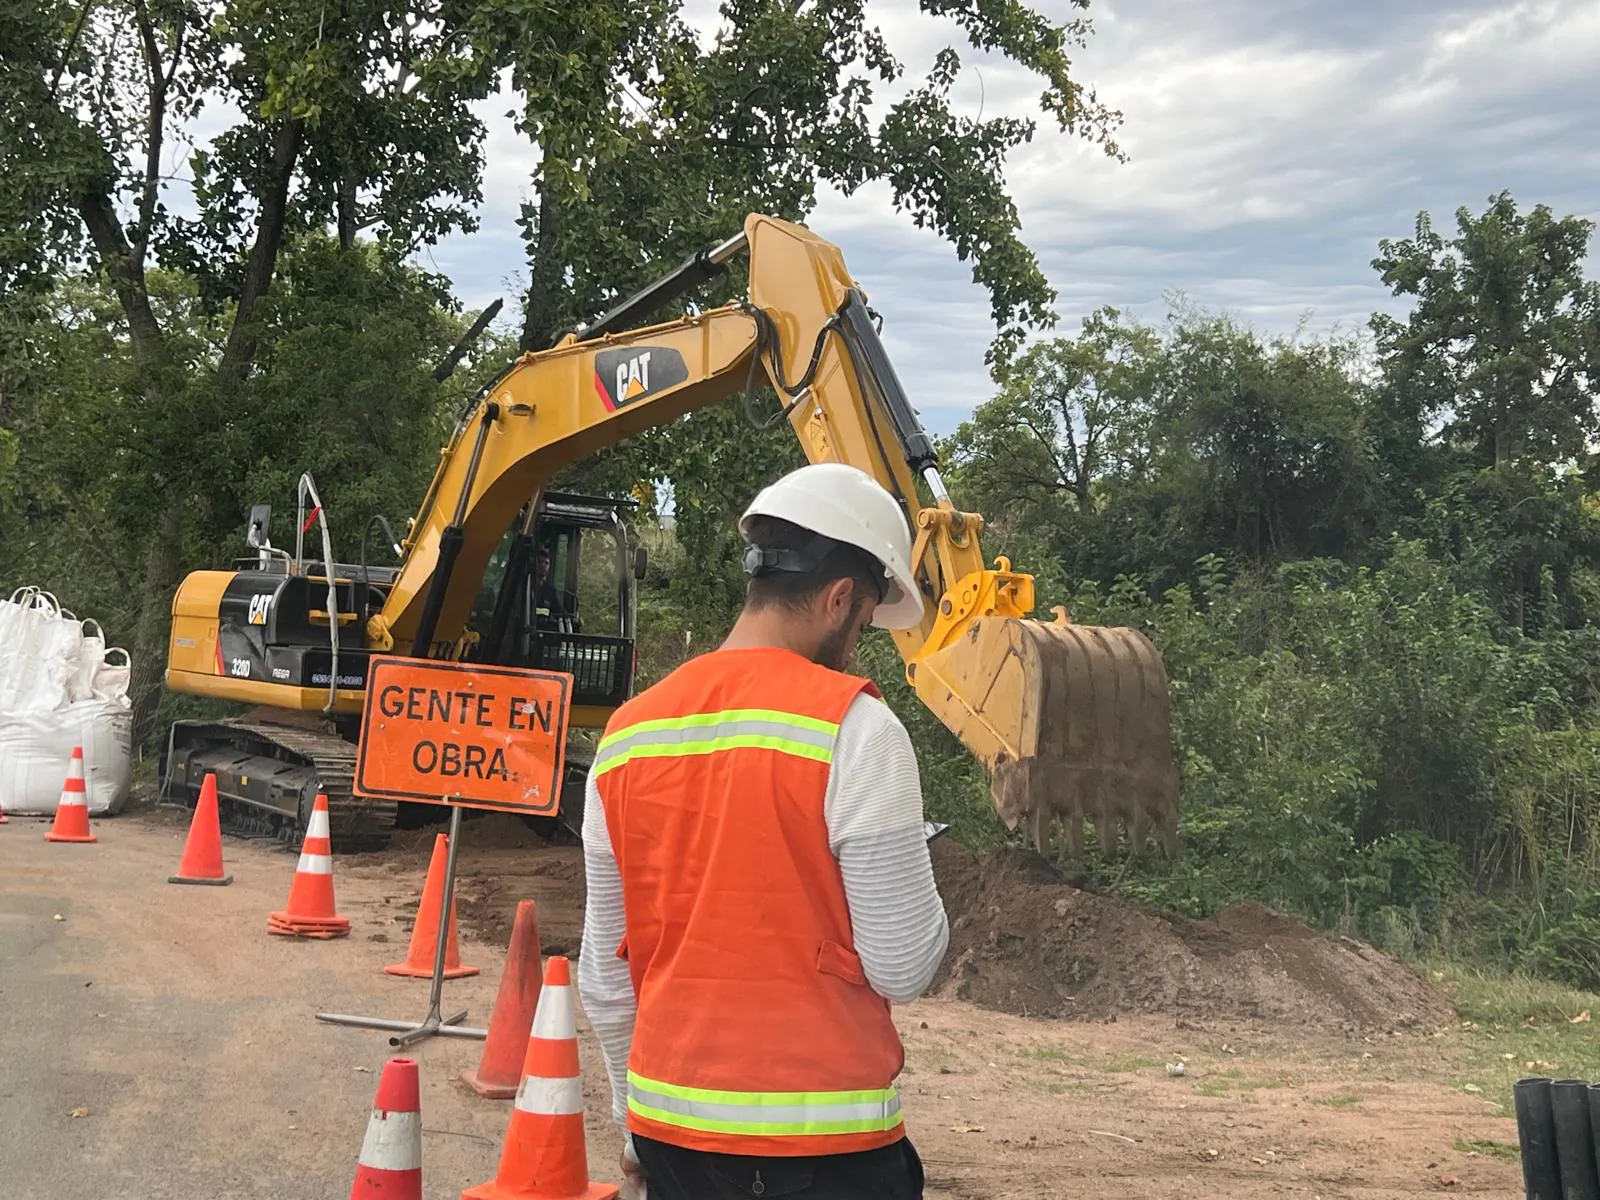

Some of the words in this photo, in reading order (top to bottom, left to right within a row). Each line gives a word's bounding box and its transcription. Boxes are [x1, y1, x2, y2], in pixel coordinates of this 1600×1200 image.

[616, 351, 651, 402] CAT
[248, 594, 273, 625] CAT
[231, 658, 251, 678] 320D
[379, 685, 496, 727] GENTE
[508, 696, 553, 733] EN
[412, 740, 508, 782] OBRA
